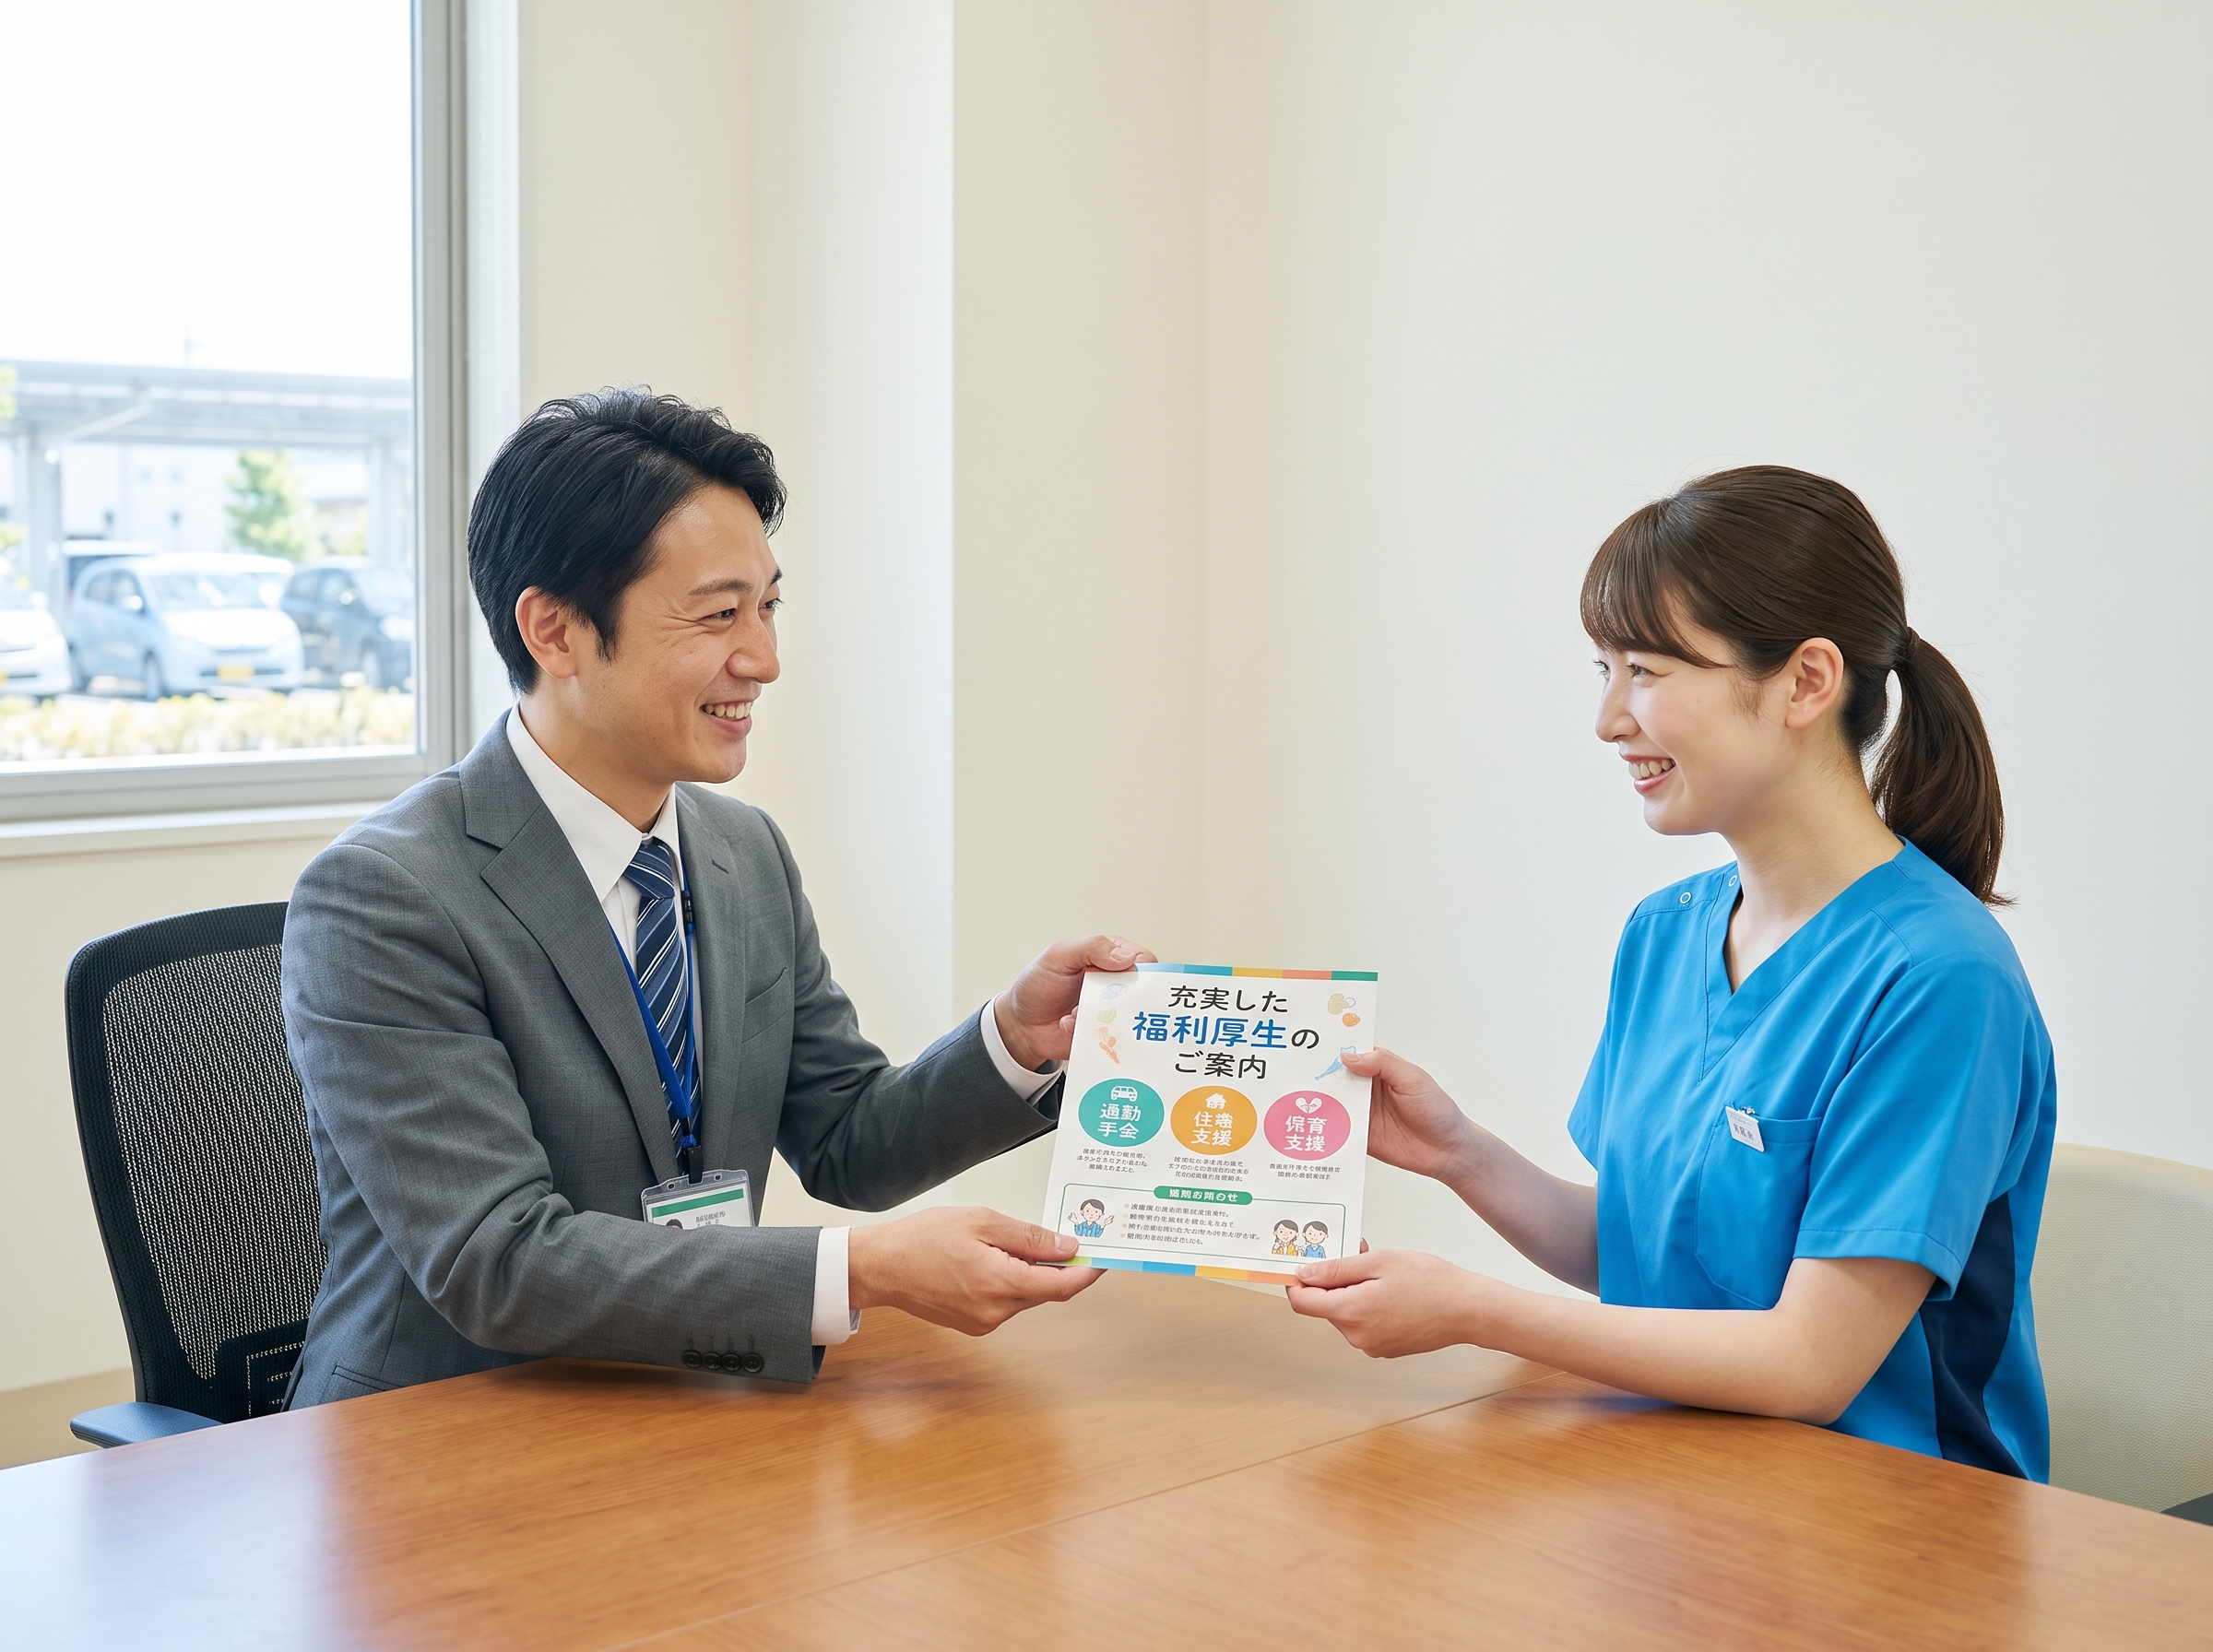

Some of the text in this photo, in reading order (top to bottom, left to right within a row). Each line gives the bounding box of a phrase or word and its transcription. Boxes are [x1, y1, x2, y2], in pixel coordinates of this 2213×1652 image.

[1168, 985, 1288, 1012] 充実した
[1132, 1011, 1320, 1049] 福利厚生の
[1175, 1050, 1267, 1080] ご案内
